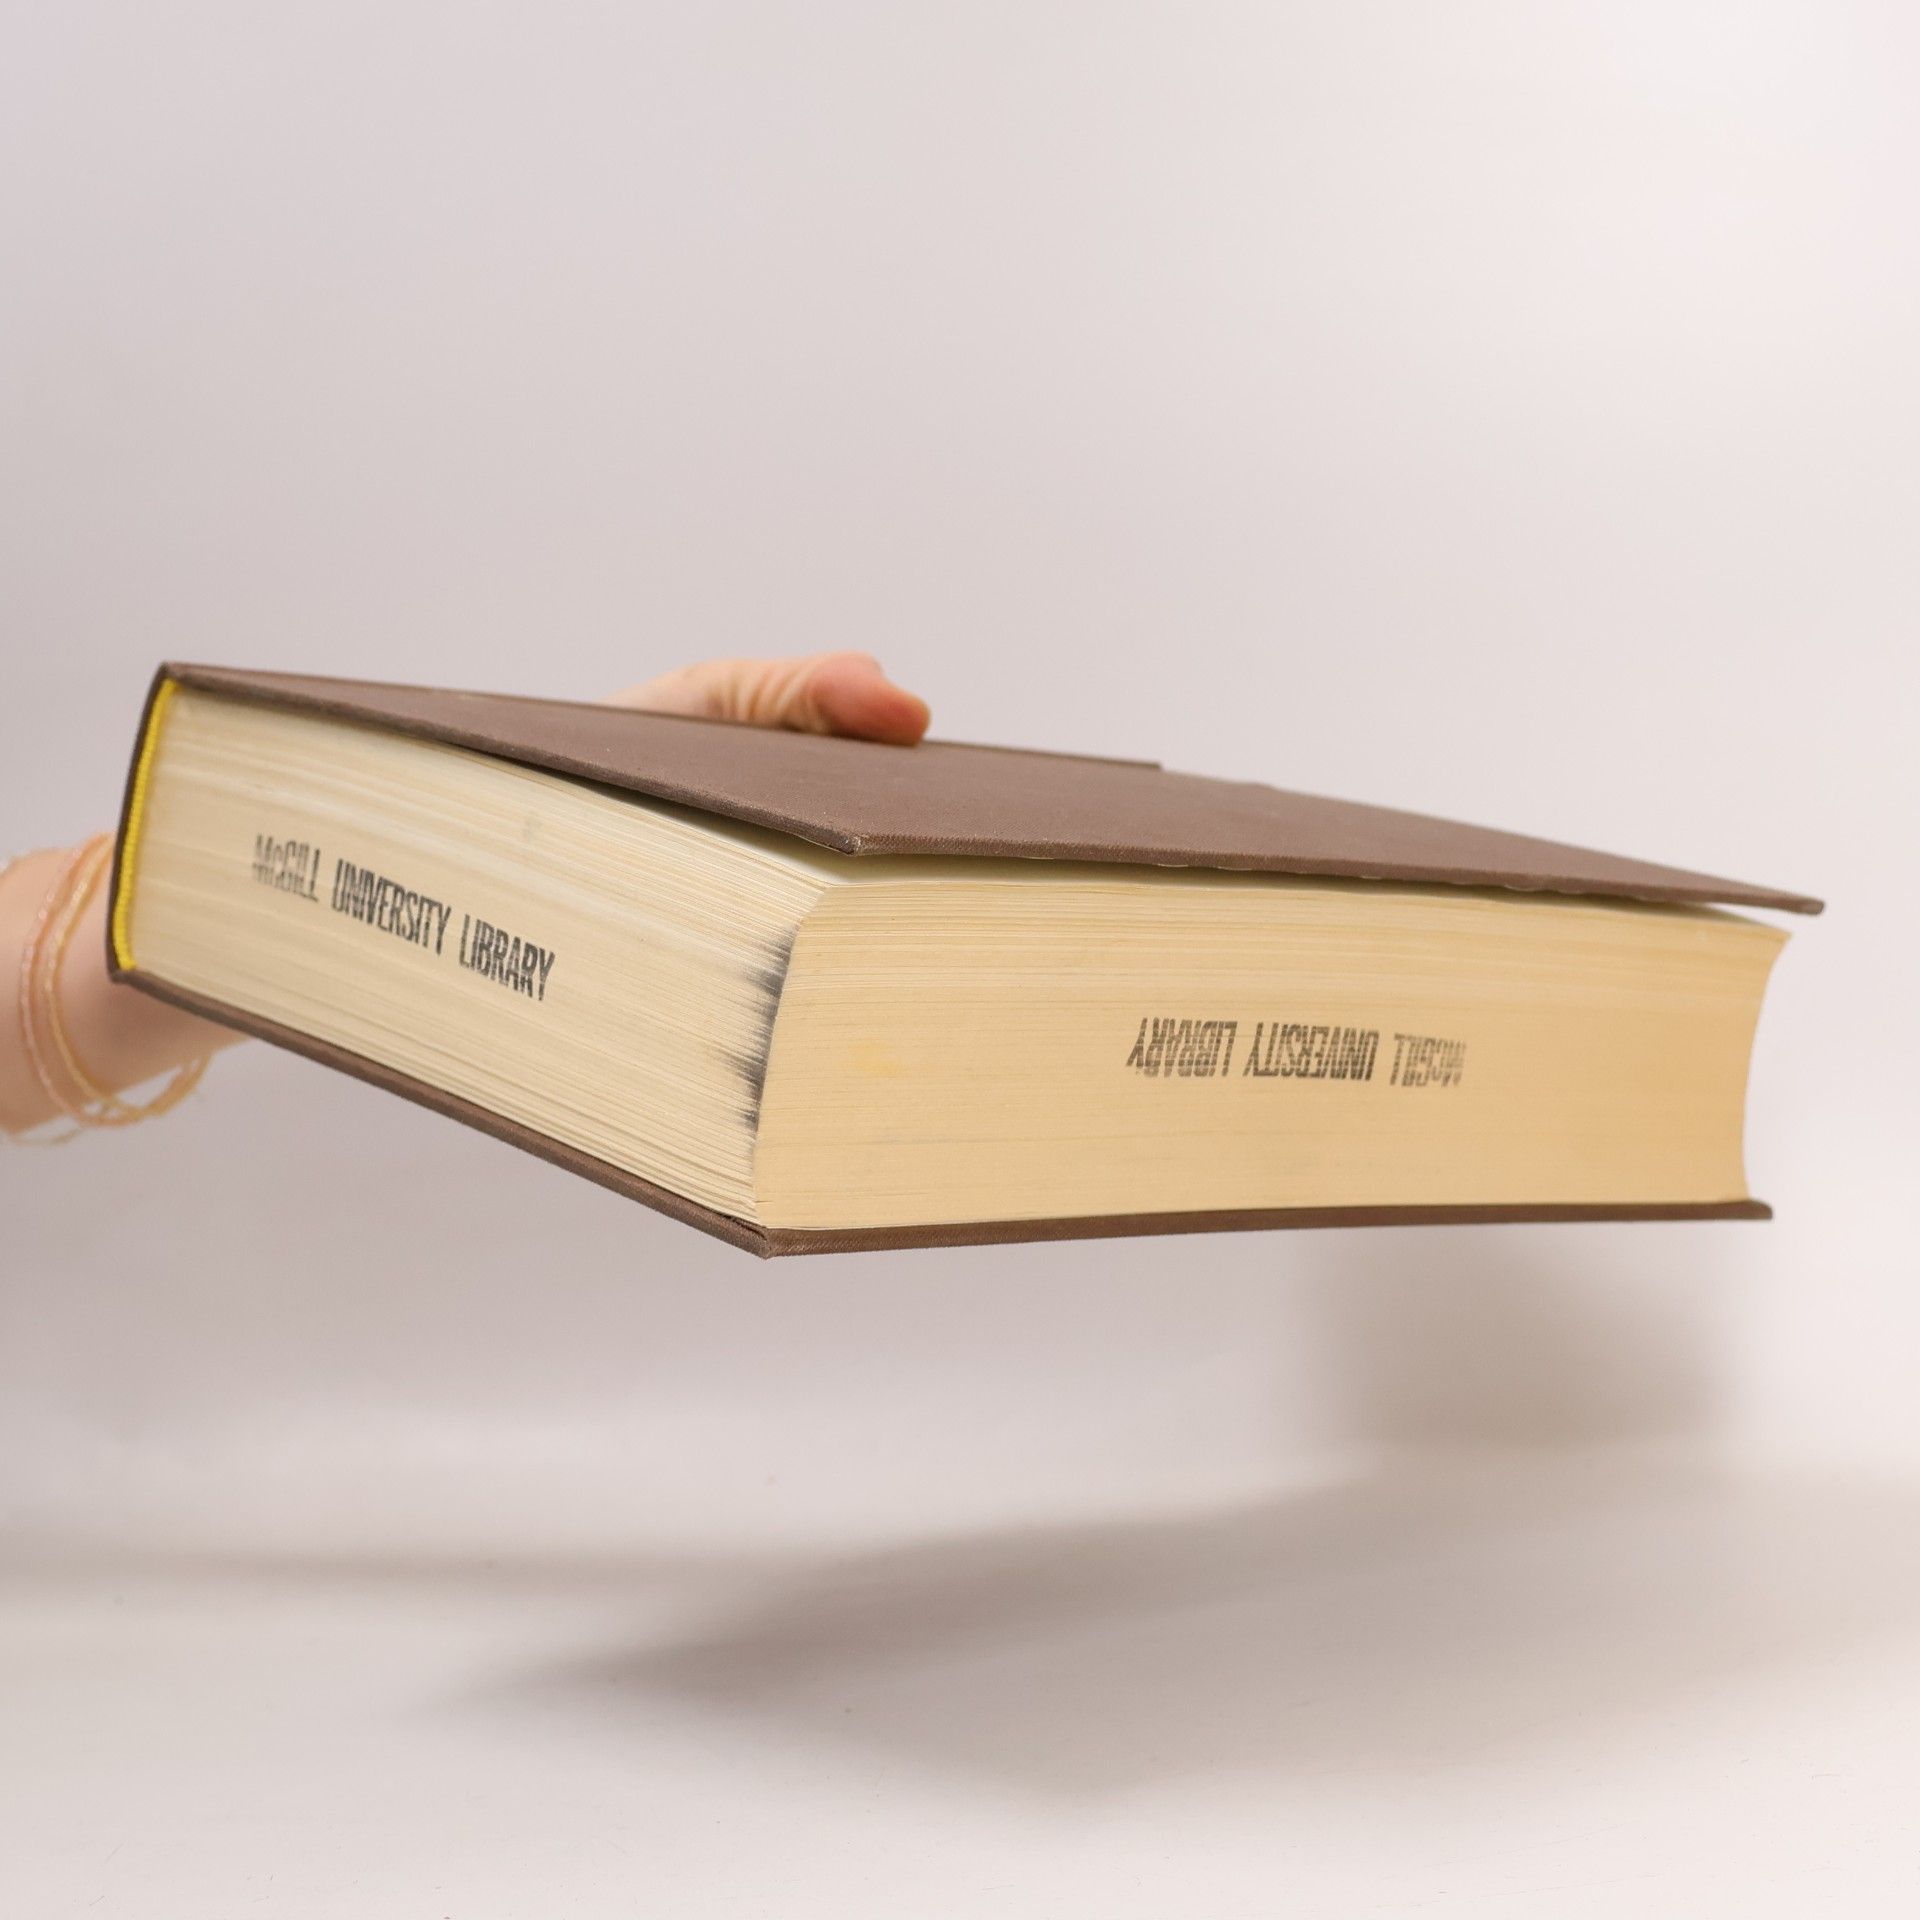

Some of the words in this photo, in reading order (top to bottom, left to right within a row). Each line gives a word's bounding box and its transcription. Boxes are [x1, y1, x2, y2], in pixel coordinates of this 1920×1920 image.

[252, 833, 320, 902] McGILL
[332, 858, 451, 955] UNIVERSITY
[459, 913, 555, 1001] LIBRARY
[1126, 1017, 1237, 1077] LIBRARY
[1243, 1022, 1379, 1081] UNIVERSITY
